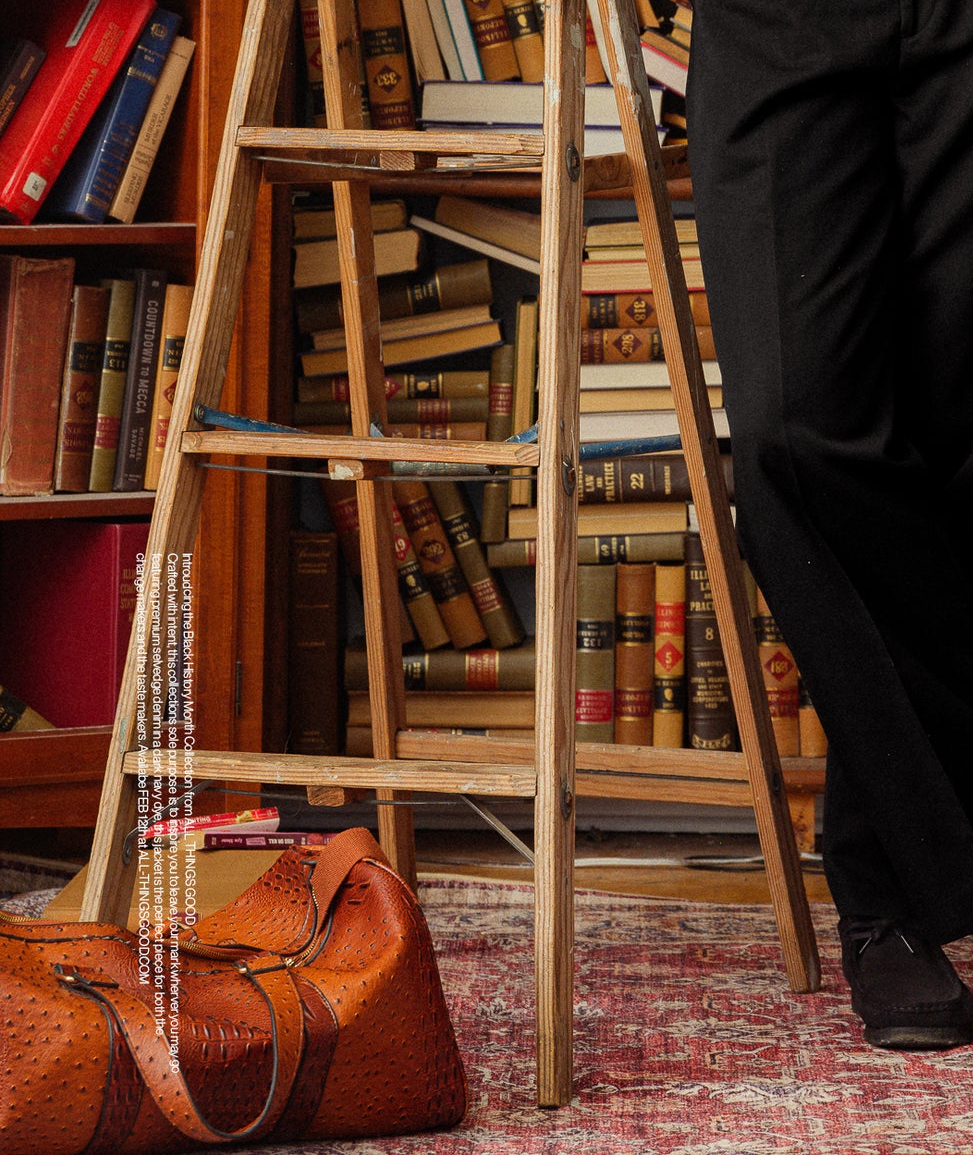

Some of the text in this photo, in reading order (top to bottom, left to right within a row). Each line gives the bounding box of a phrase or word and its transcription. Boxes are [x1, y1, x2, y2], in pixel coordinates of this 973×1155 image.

[56, 66, 99, 140] WORLD LEADERS
[135, 300, 159, 415] COUNTDOWN TO MECCA
[129, 429, 138, 459] SAVAGE
[136, 427, 146, 462] MICHAEL
[584, 474, 595, 493] LAW
[604, 462, 616, 502] PRACTICE
[630, 473, 644, 490] 22
[705, 628, 714, 641] 8
[664, 652, 672, 664] 5
